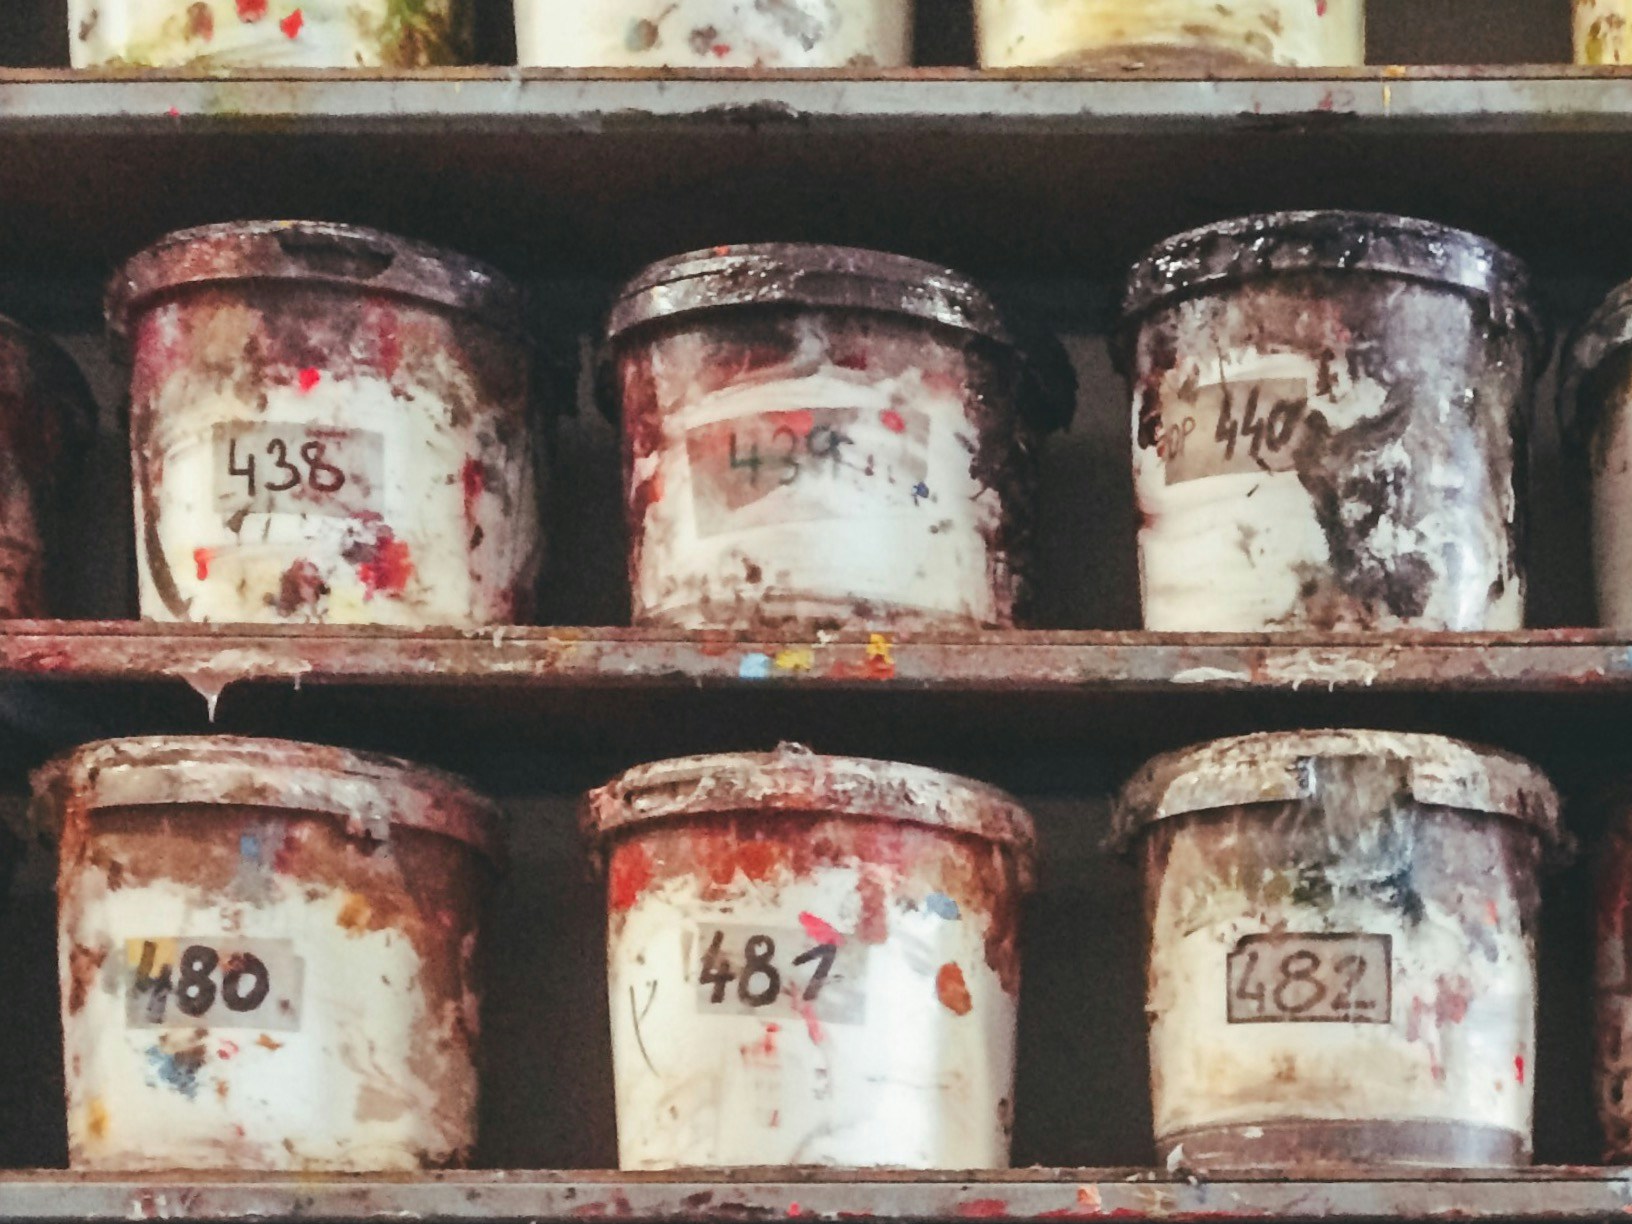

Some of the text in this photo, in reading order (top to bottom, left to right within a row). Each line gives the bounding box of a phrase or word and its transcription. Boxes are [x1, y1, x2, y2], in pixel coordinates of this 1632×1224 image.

[729, 424, 841, 487] 439
[1214, 382, 1305, 461] 440
[228, 437, 346, 497] 438
[133, 942, 270, 1028] 480
[1236, 942, 1375, 1014] 482
